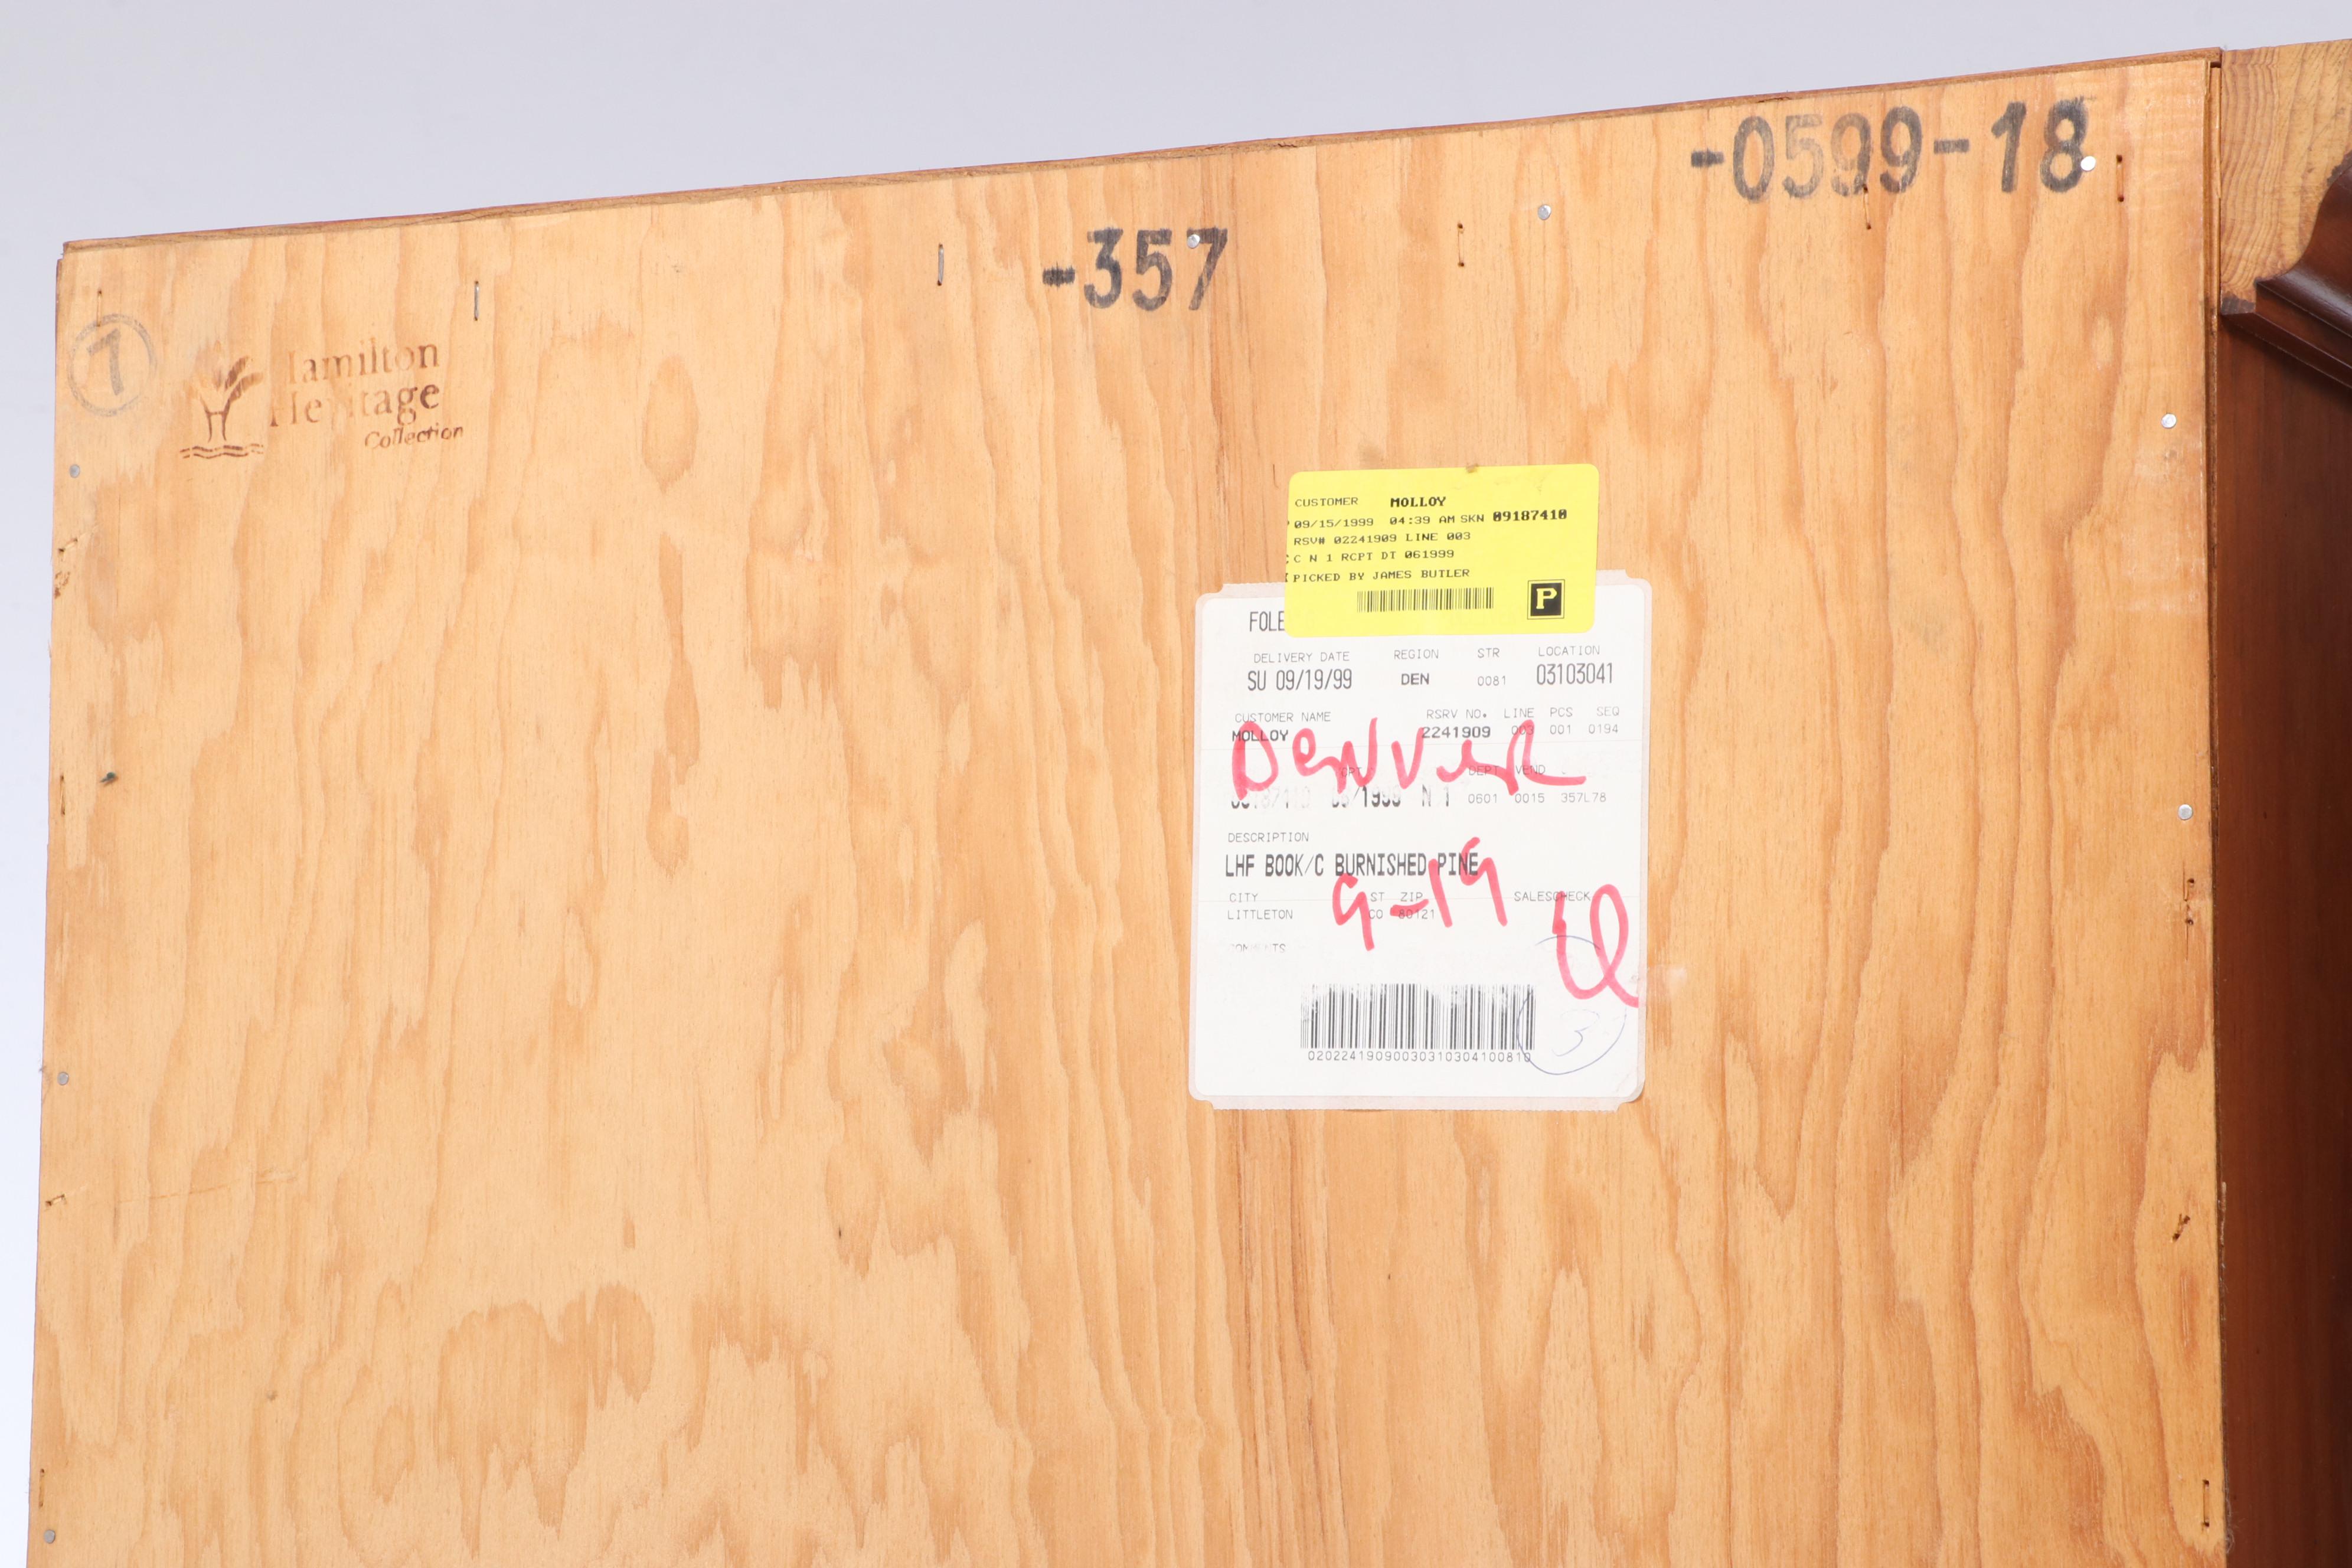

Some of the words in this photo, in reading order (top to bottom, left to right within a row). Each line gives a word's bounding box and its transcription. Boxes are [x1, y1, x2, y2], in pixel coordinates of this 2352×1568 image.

[1041, 225, 1228, 312] -357
[364, 422, 465, 449] Collection
[1295, 497, 1358, 507] CUSTOMER
[1390, 496, 1446, 508] MOLLOY
[1294, 518, 1374, 528] 09/15/1999
[1389, 515, 1430, 525] 04:39
[1439, 515, 1455, 524] AM
[1461, 514, 1485, 523] SKN
[1492, 509, 1567, 522] 09187410
[1293, 537, 1325, 546] RSV#
[1334, 534, 1397, 544] 02241909
[1405, 533, 1439, 542] LINE
[1446, 531, 1471, 541] 003
[1293, 554, 1301, 563] C
[1309, 554, 1317, 563] N
[1326, 553, 1332, 562] 1
[1341, 552, 1373, 561] RCPT
[1381, 551, 1397, 560] DT
[1404, 549, 1455, 559] 061999
[1293, 572, 1341, 583] PICKED
[1349, 571, 1365, 581] BY
[1372, 570, 1412, 580] JAMES
[1420, 569, 1470, 579] BUTLER
[1536, 587, 1557, 609] P
[1393, 649, 1439, 660] REGION
[1477, 648, 1500, 659] STR
[1538, 645, 1600, 657] LOCATION
[1253, 652, 1312, 664] DELIVERY
[1320, 651, 1350, 662] DATE
[1400, 672, 1430, 685] DEN
[1536, 662, 1613, 685] 03103041
[1247, 669, 1267, 691] SU
[1275, 668, 1353, 691] 09/19/99
[1477, 675, 1507, 687] 0081
[1426, 708, 1458, 719] RSRV
[1465, 708, 1487, 718] NO.
[1504, 707, 1535, 718] LINE
[1550, 707, 1573, 717] PCS
[1596, 706, 1620, 717] SEQ
[1234, 713, 1294, 724] CUSTOMER
[1301, 711, 1331, 723] NAME
[1422, 726, 1491, 739] 2241909
[1511, 724, 1534, 736] 003
[1550, 724, 1572, 735] 001
[1588, 723, 1619, 734] 0194
[1231, 730, 1289, 742] MOLLOY
[1468, 765, 1500, 776] DEPT
[1515, 765, 1546, 775] VEND
[1468, 793, 1497, 804] 0601
[1514, 793, 1545, 803] 0015
[1228, 832, 1309, 843] DESCRIPTION
[1225, 854, 1255, 877] LHF
[1265, 853, 1324, 877] BOOK/C
[1335, 852, 1427, 876] BURNISHED
[1438, 852, 1478, 877] PINE
[1229, 892, 1259, 903] CITY
[1370, 892, 1385, 902] ST
[1400, 891, 1423, 902] ZIP
[1514, 891, 1591, 902] SALESCHECK
[1227, 909, 1293, 920] LITTLETON
[1368, 909, 1384, 919] CO
[1398, 909, 1435, 919] 80121
